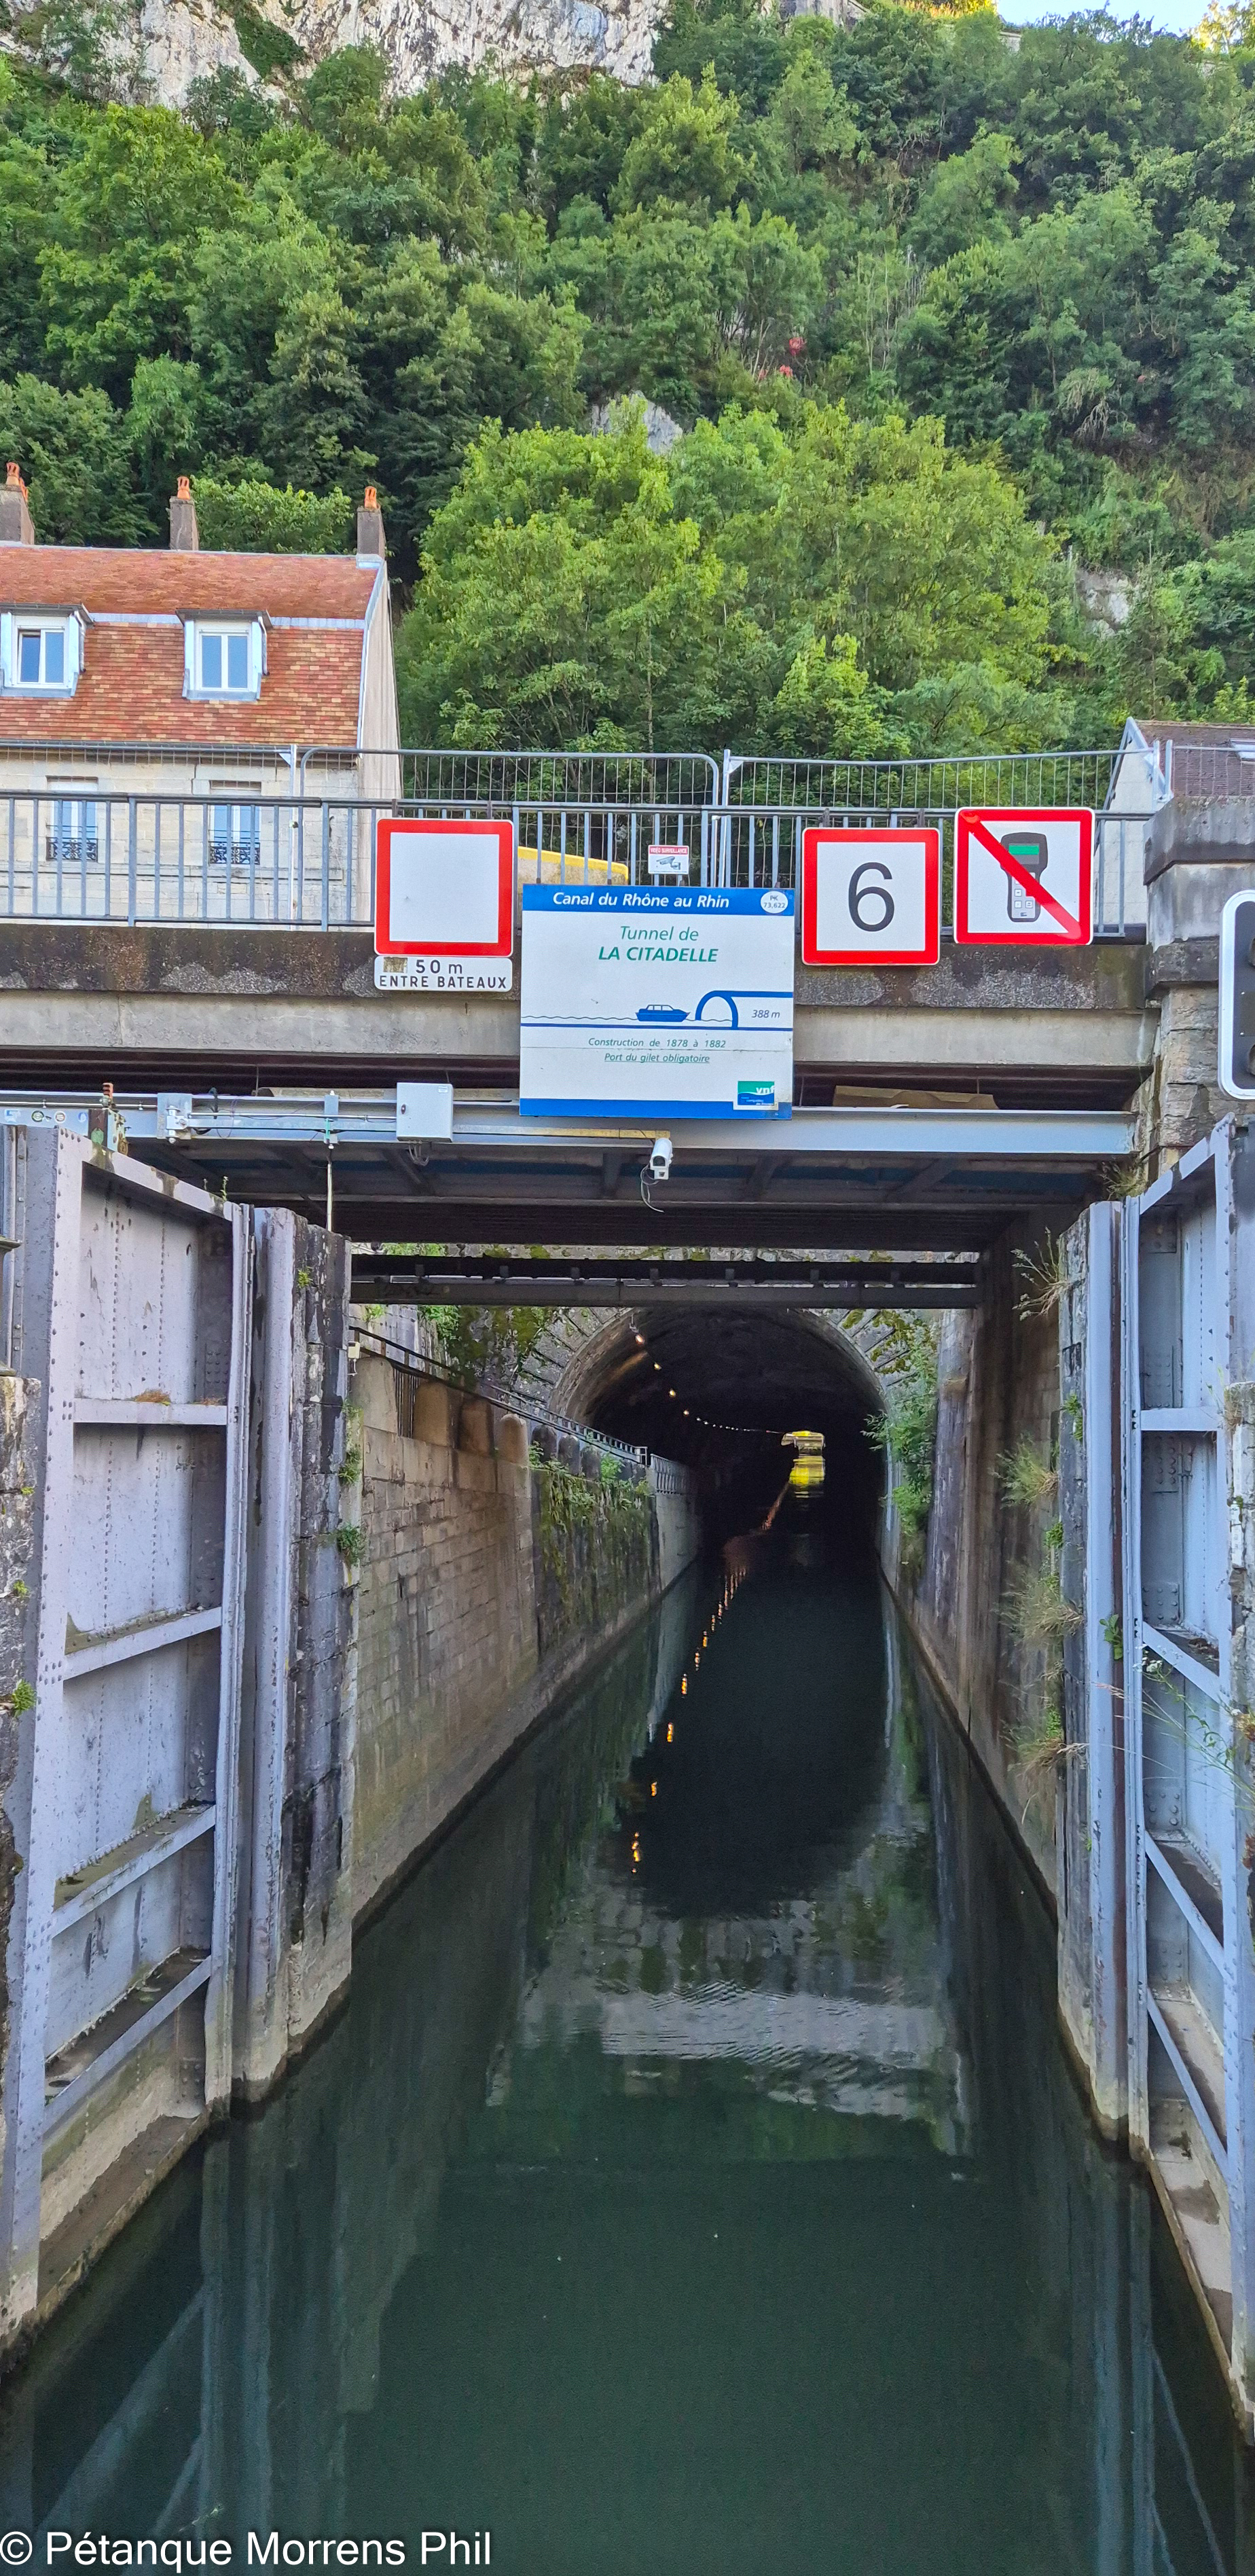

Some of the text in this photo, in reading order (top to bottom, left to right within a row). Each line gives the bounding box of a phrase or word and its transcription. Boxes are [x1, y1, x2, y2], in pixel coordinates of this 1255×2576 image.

[553, 892, 730, 908] Canal du Rhône au Rhin
[848, 861, 895, 933] 6
[620, 925, 699, 942] Tunnel de
[598, 946, 719, 963] LA CITADELLE
[416, 959, 462, 974] 50 m
[380, 975, 507, 989] ENTRE BATEAUX
[751, 1009, 769, 1018] 388
[588, 1037, 726, 1048] Construction de 1878 à 1882
[604, 1053, 710, 1064] Port du gilet obligatoire
[756, 1086, 775, 1094] vnf
